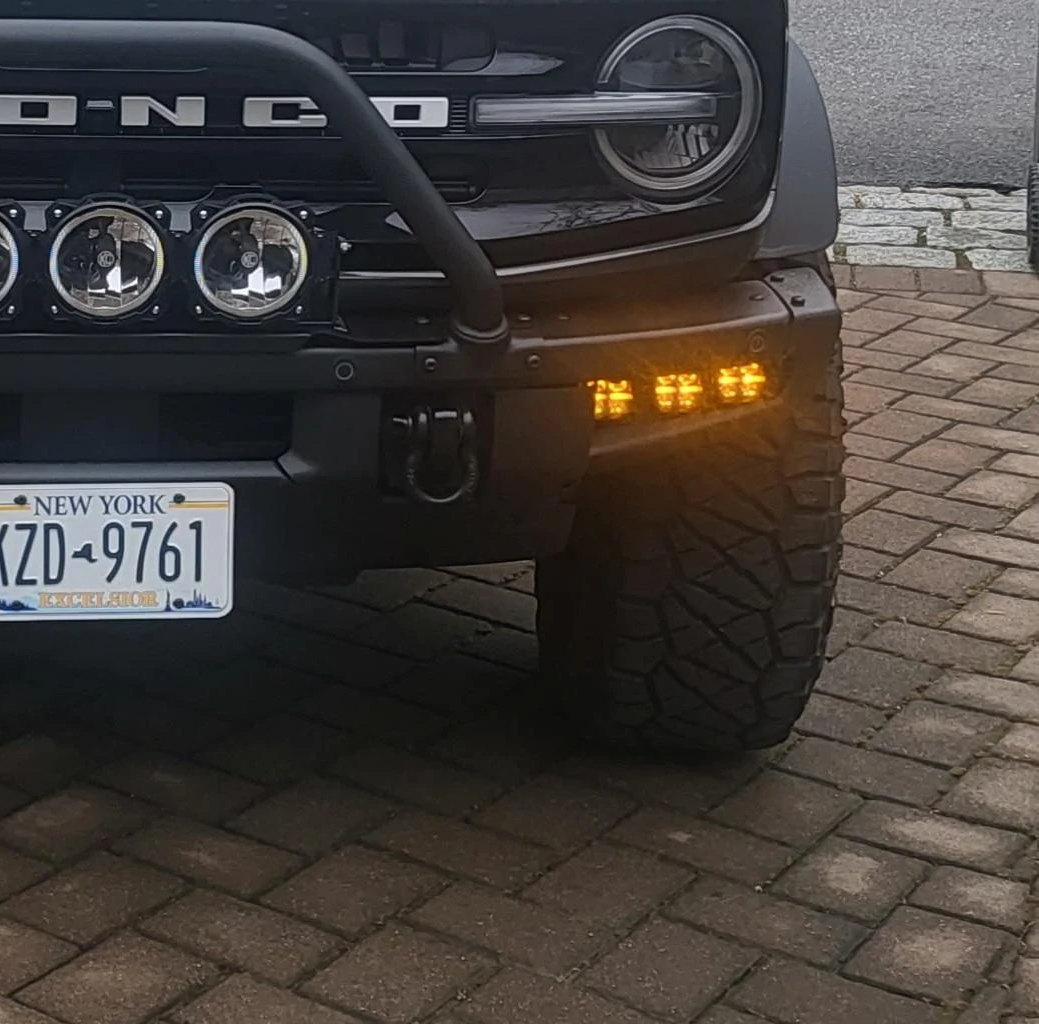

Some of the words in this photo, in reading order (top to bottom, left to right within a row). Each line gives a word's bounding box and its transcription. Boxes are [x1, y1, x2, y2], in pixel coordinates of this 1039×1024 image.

[34, 495, 94, 516] NEW
[95, 494, 167, 515] YORK
[102, 520, 203, 584] 9761
[37, 590, 159, 609] EXCELSIOR
